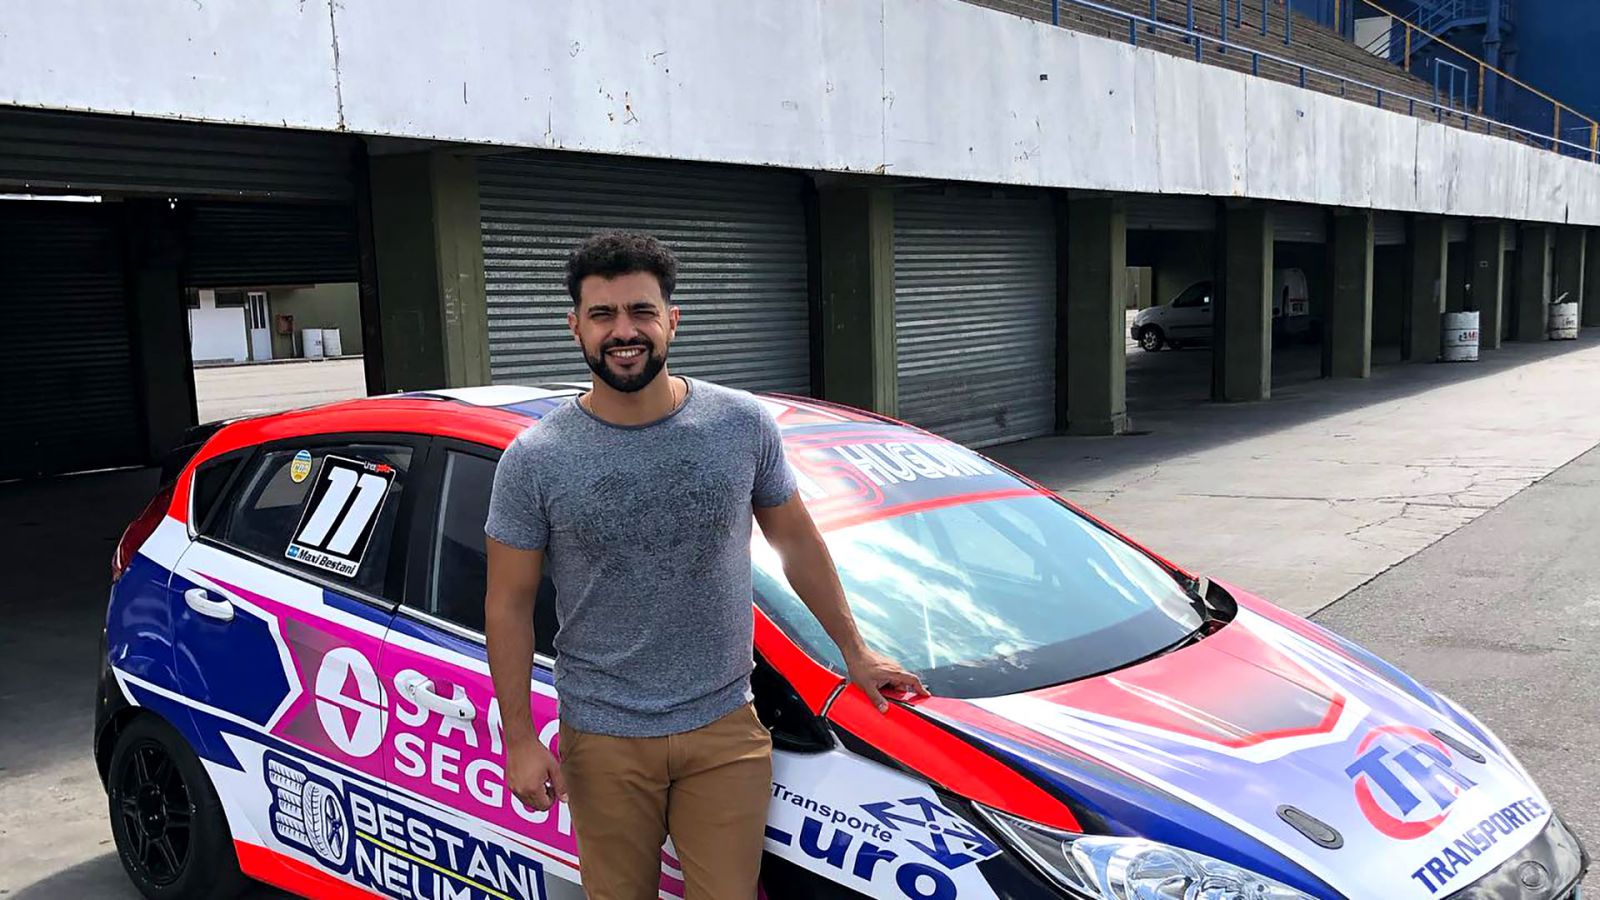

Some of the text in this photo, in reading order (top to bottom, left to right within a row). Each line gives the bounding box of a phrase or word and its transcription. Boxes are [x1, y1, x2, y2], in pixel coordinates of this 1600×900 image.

[297, 466, 388, 555] 11
[297, 549, 357, 575] Maxi Bestani
[350, 791, 540, 900] BESTANI
[772, 782, 893, 843] Transporte
[1411, 797, 1546, 894] TRANSPORTES
[356, 839, 491, 900] NEUM
[765, 816, 958, 900] uro
